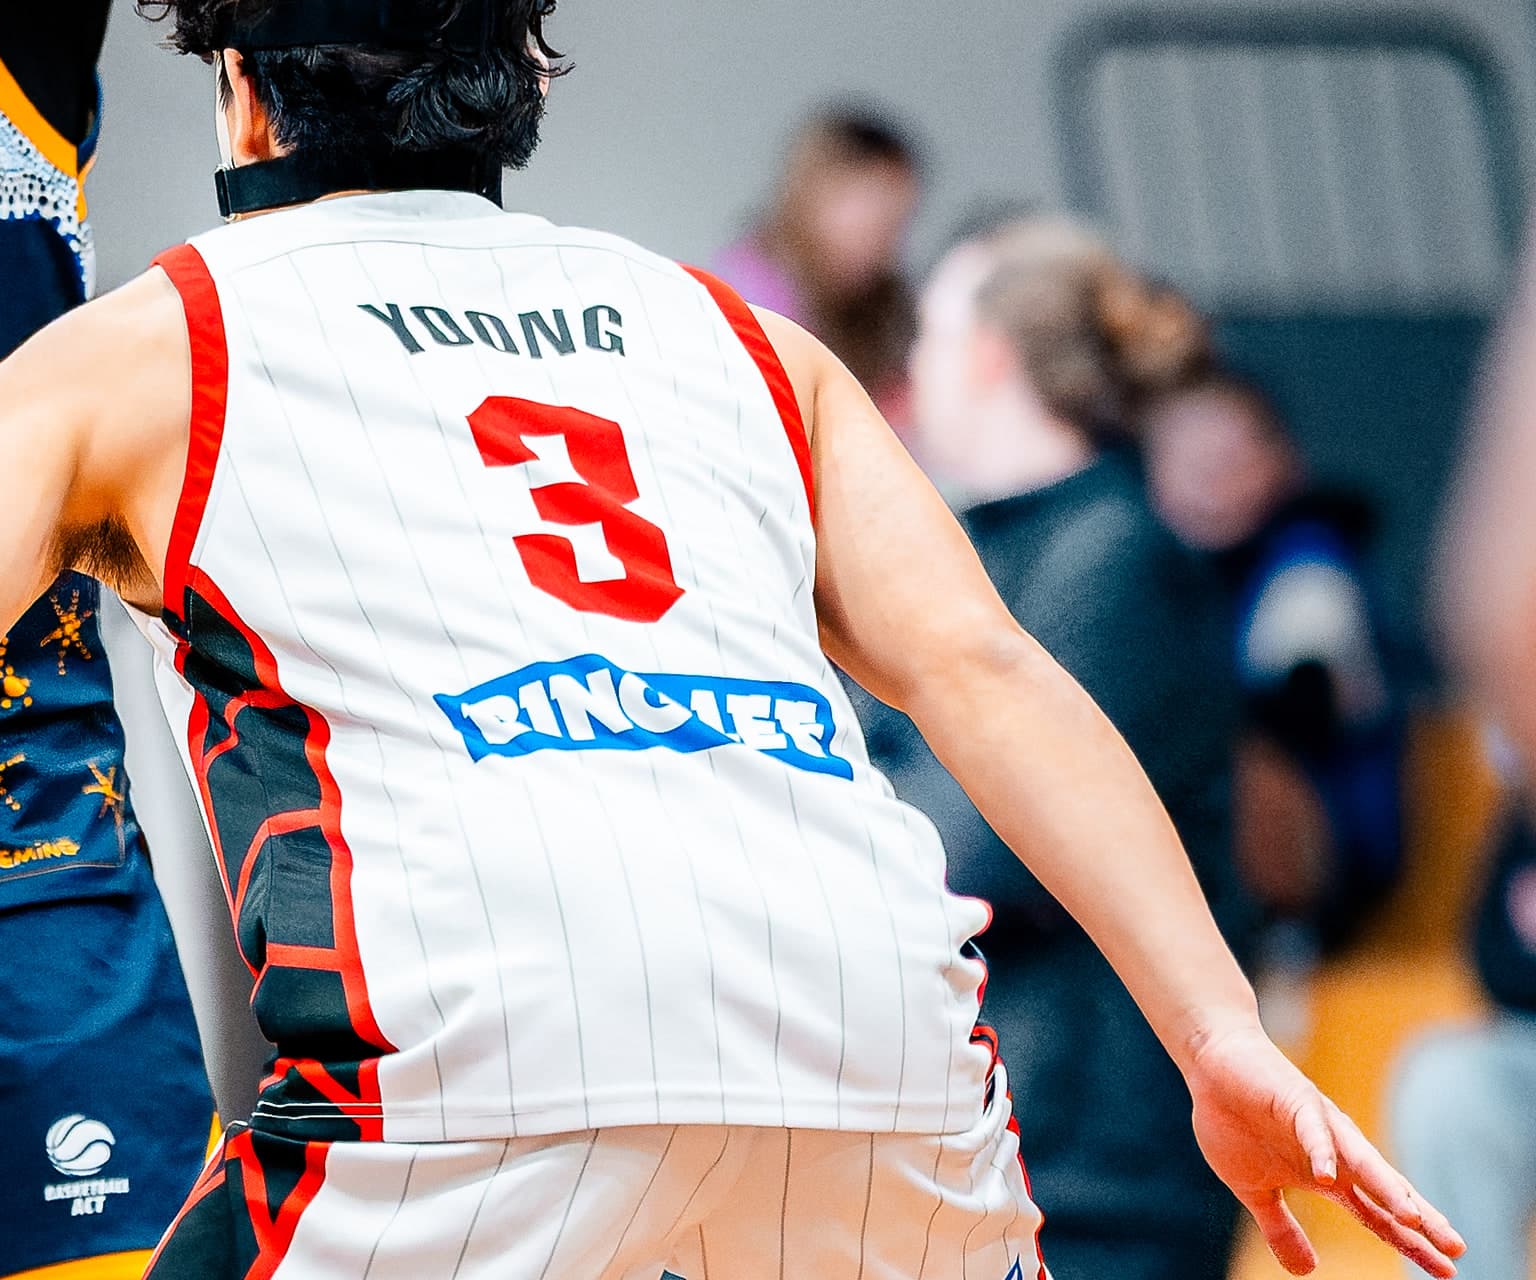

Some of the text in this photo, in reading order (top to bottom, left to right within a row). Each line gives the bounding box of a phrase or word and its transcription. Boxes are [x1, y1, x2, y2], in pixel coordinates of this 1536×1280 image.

[357, 303, 625, 359] YOONG
[466, 395, 686, 623] 3
[71, 1195, 106, 1216] ACT
